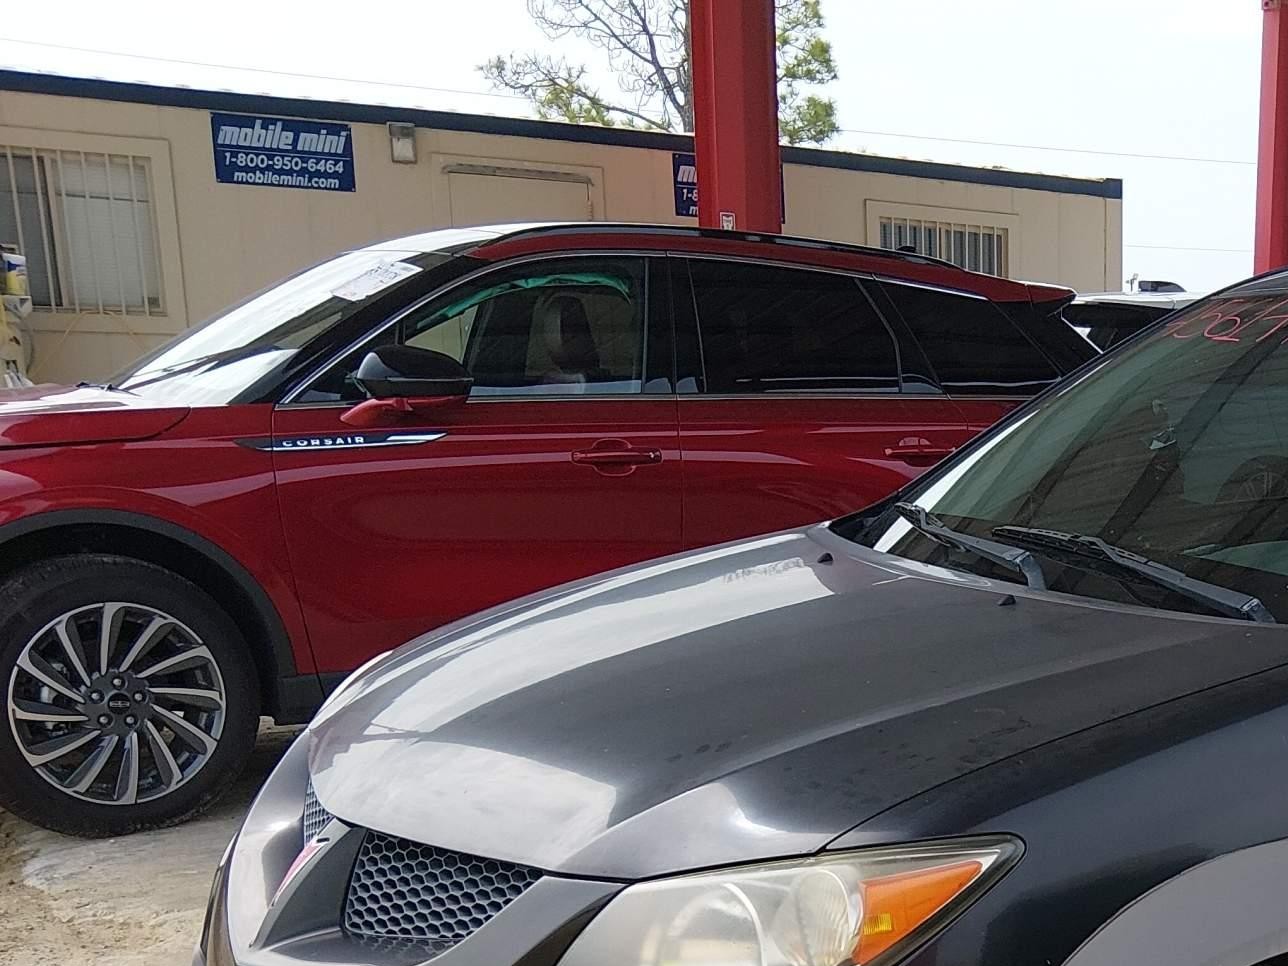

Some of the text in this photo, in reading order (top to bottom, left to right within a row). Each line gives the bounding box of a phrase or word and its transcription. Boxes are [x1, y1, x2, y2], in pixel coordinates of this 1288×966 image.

[217, 119, 347, 154] mobile mini
[224, 152, 344, 173] 1-800-950-6464
[233, 170, 340, 188] mobilemini.com
[283, 436, 364, 446] CORSAIR
